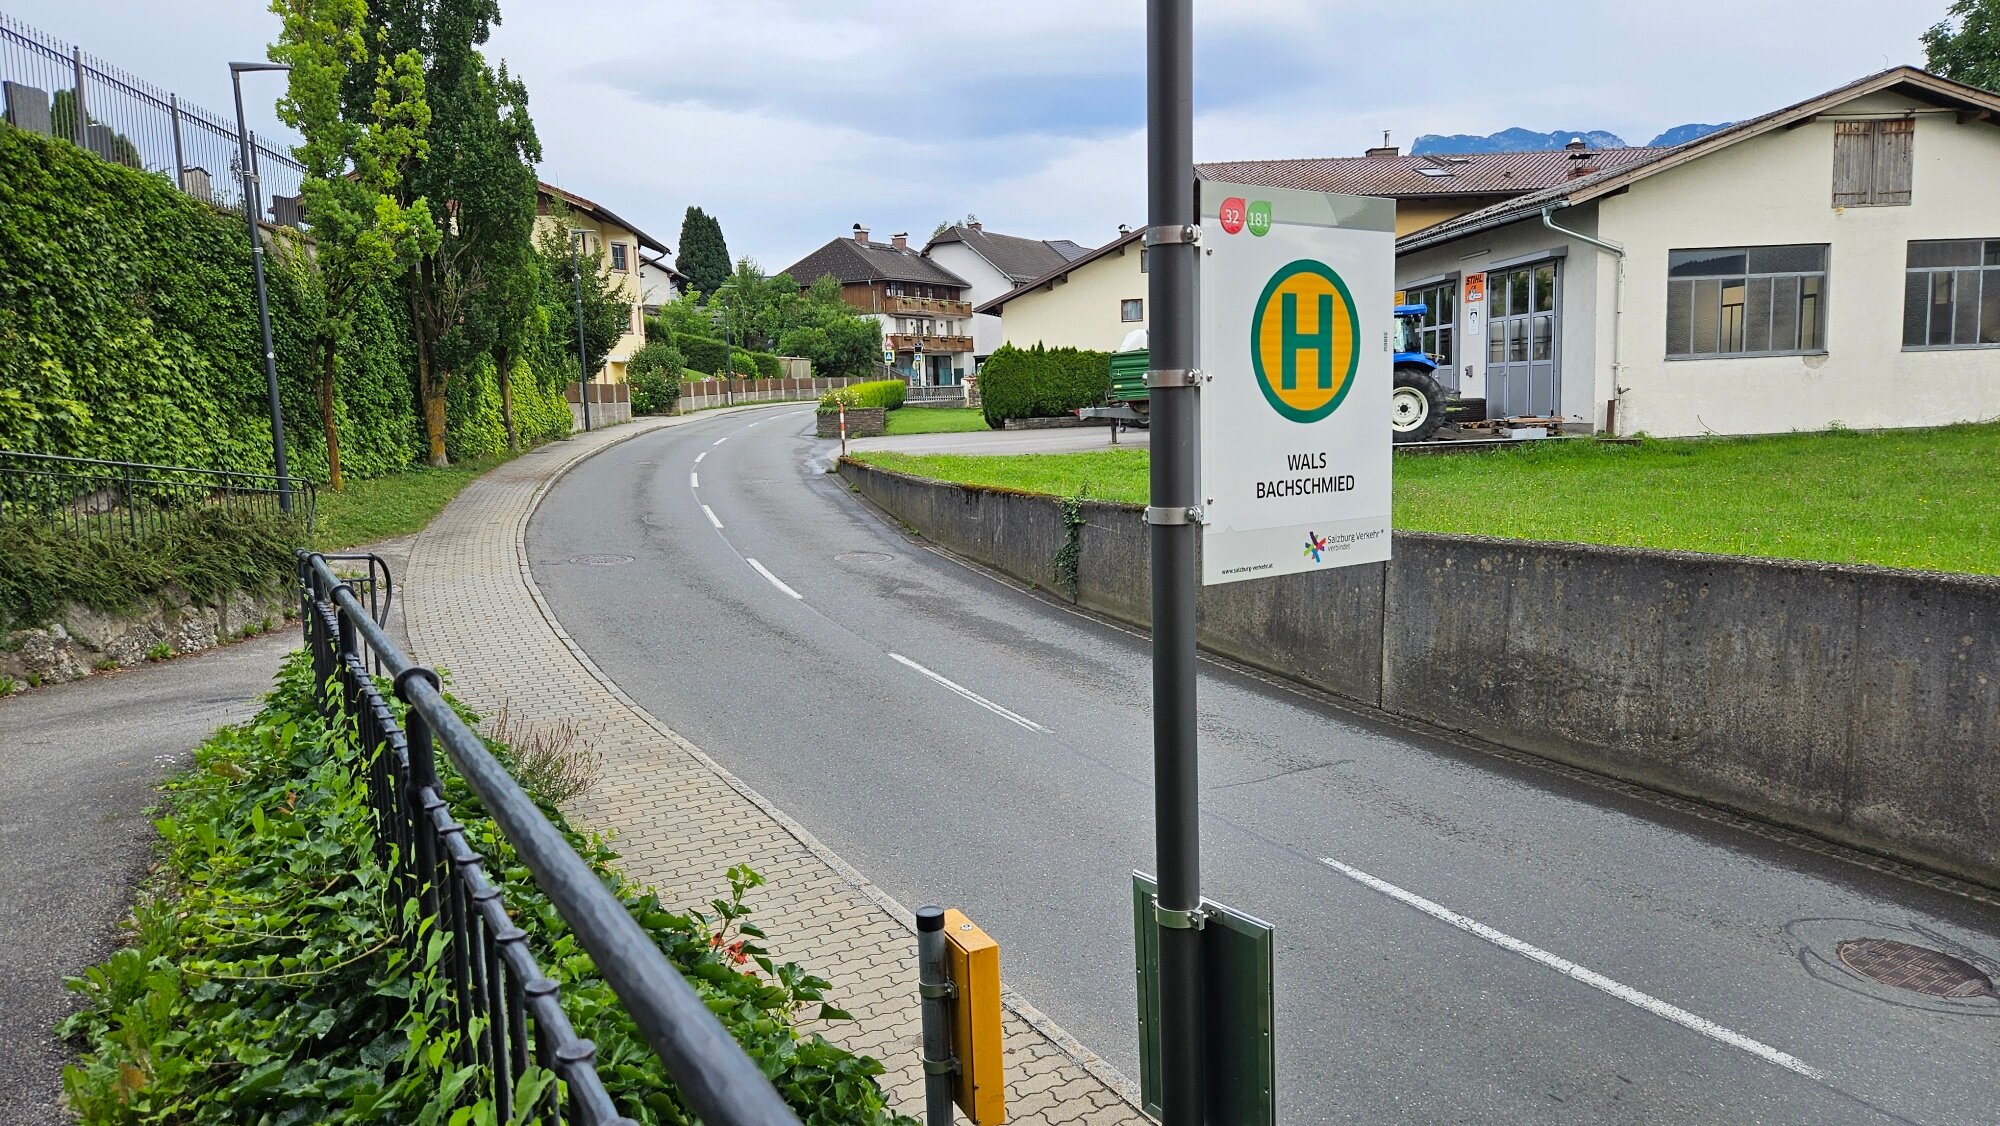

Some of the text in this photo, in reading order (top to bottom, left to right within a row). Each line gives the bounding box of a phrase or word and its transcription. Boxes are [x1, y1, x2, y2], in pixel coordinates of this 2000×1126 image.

[1225, 209, 1239, 224] 32
[1249, 212, 1269, 227] 181
[1465, 274, 1484, 286] STIHL
[1281, 293, 1333, 391] H
[1287, 452, 1327, 471] WALS
[1256, 474, 1355, 499] BACHSCHMIED
[1327, 531, 1355, 545] Salzburg
[1327, 543, 1351, 552] verbindet
[1221, 562, 1274, 575] www.salzburg-verkehr.at
